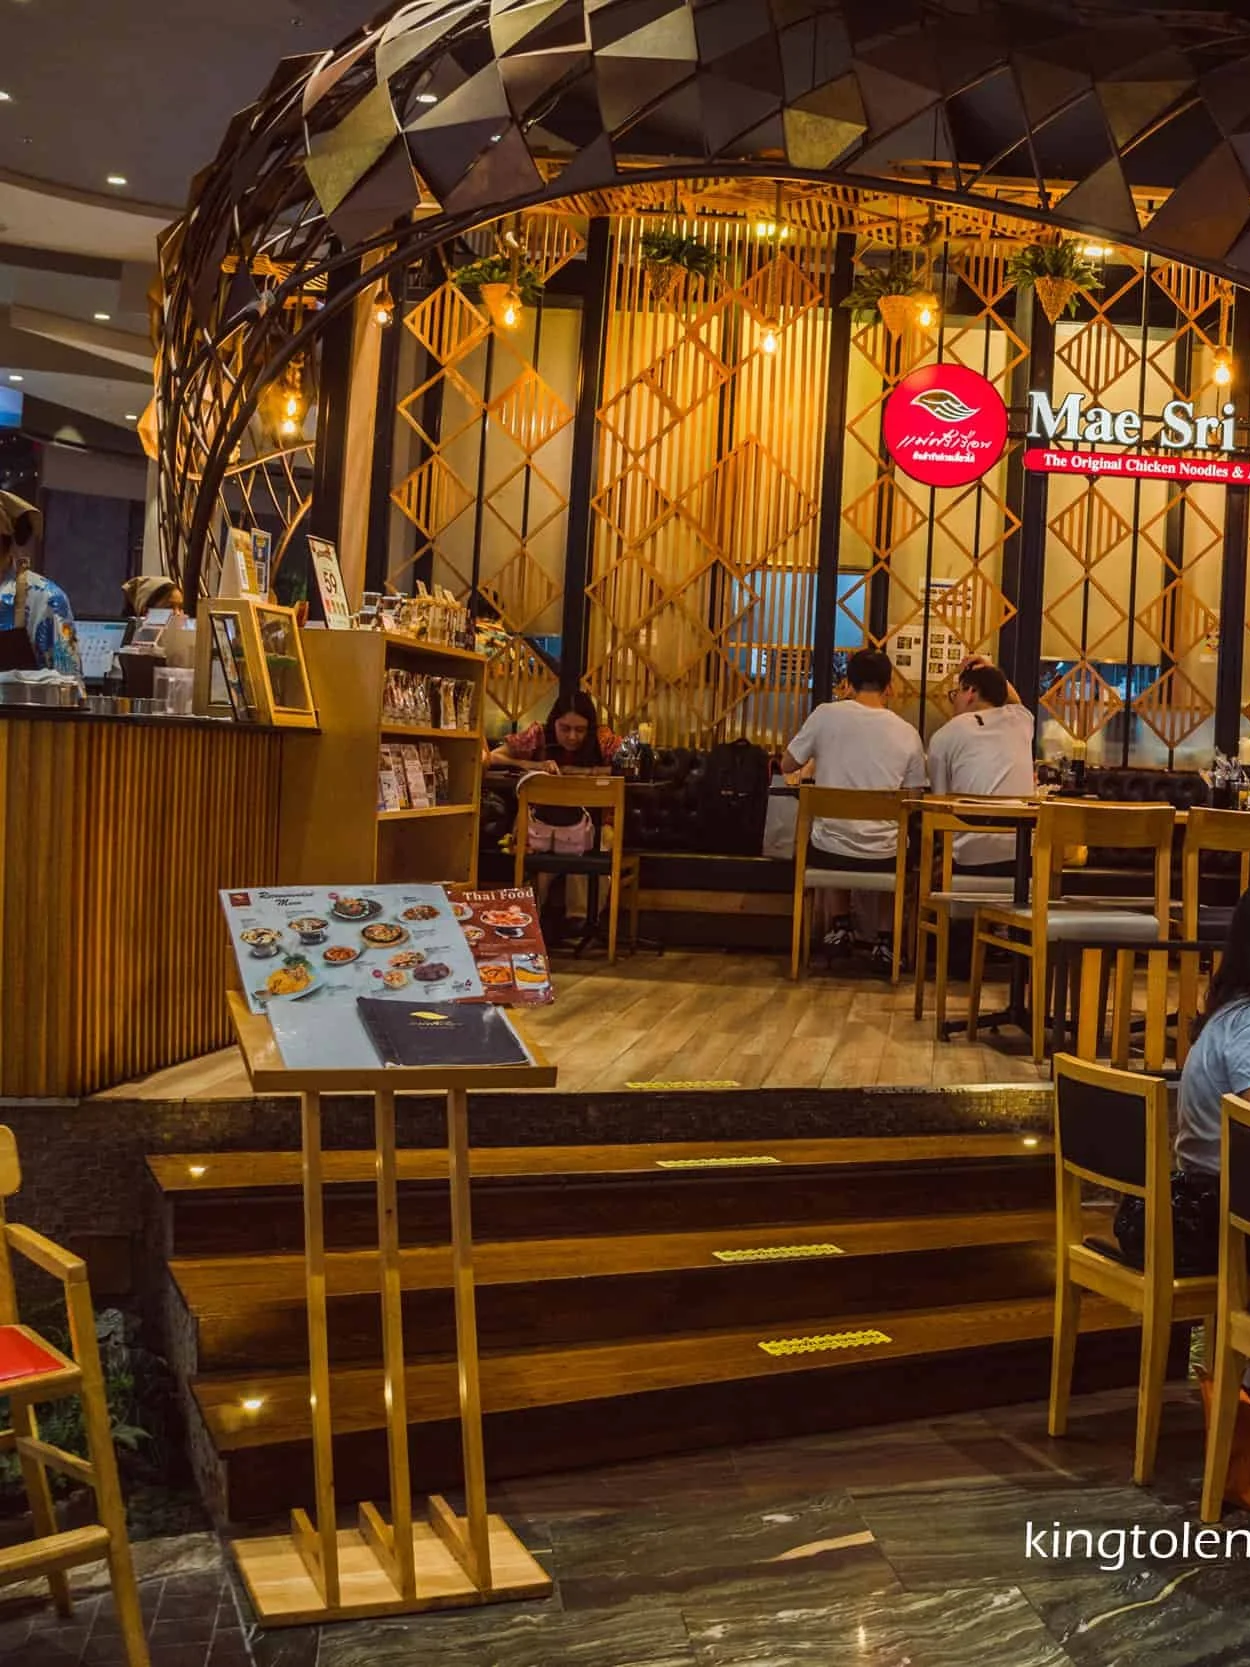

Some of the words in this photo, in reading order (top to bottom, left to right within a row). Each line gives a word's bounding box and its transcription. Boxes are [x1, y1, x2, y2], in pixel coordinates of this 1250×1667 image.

[1026, 391, 1141, 445] Mae
[1160, 400, 1236, 451] Sri
[1043, 453, 1067, 468] The
[1071, 455, 1122, 472] Original
[1125, 458, 1176, 474] Chicken
[1179, 462, 1229, 478] Noodles
[1231, 466, 1244, 479] &
[323, 571, 337, 594] 59
[462, 890, 496, 901] Thai
[499, 887, 534, 901] Food
